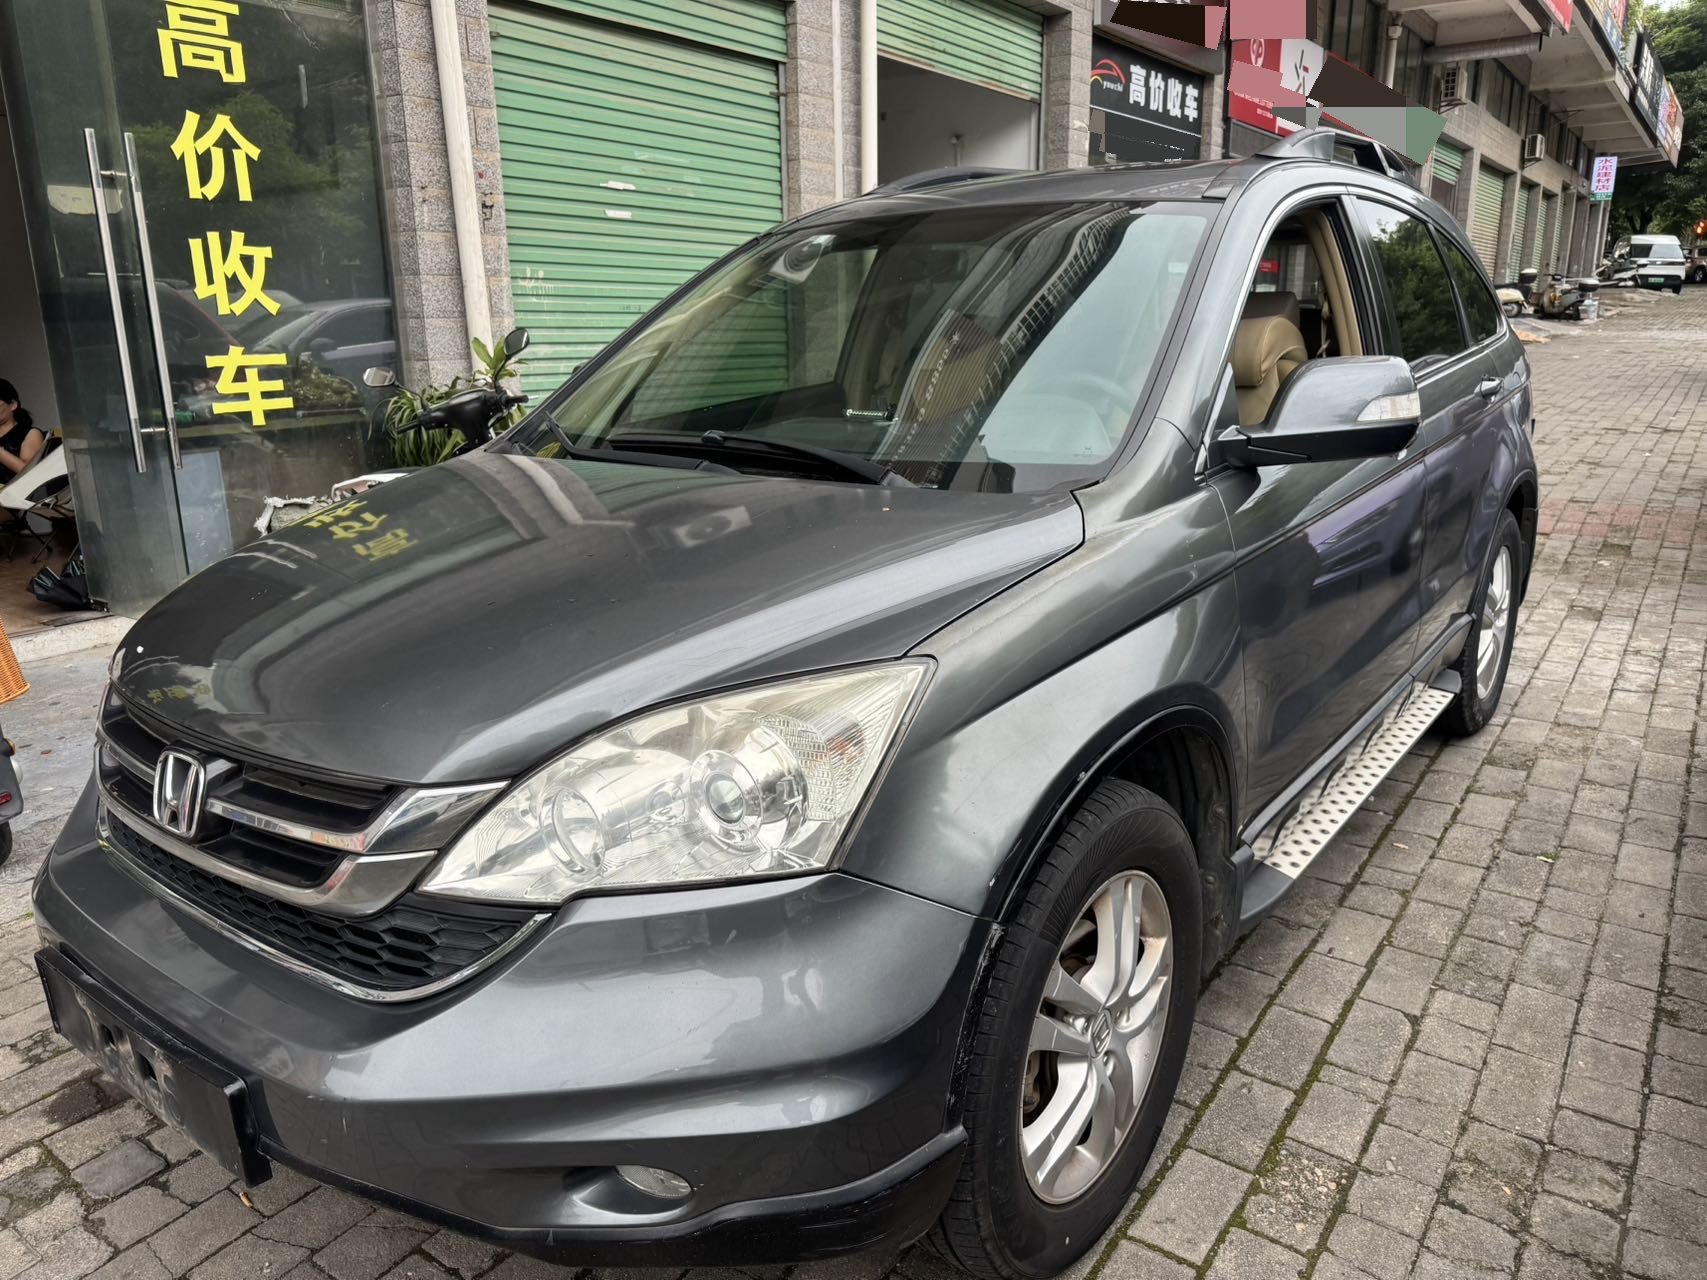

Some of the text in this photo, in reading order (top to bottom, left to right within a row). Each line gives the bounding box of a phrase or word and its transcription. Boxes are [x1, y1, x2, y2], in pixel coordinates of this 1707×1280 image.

[157, 0, 294, 426] 高价收车
[1129, 64, 1199, 122] 高价收车
